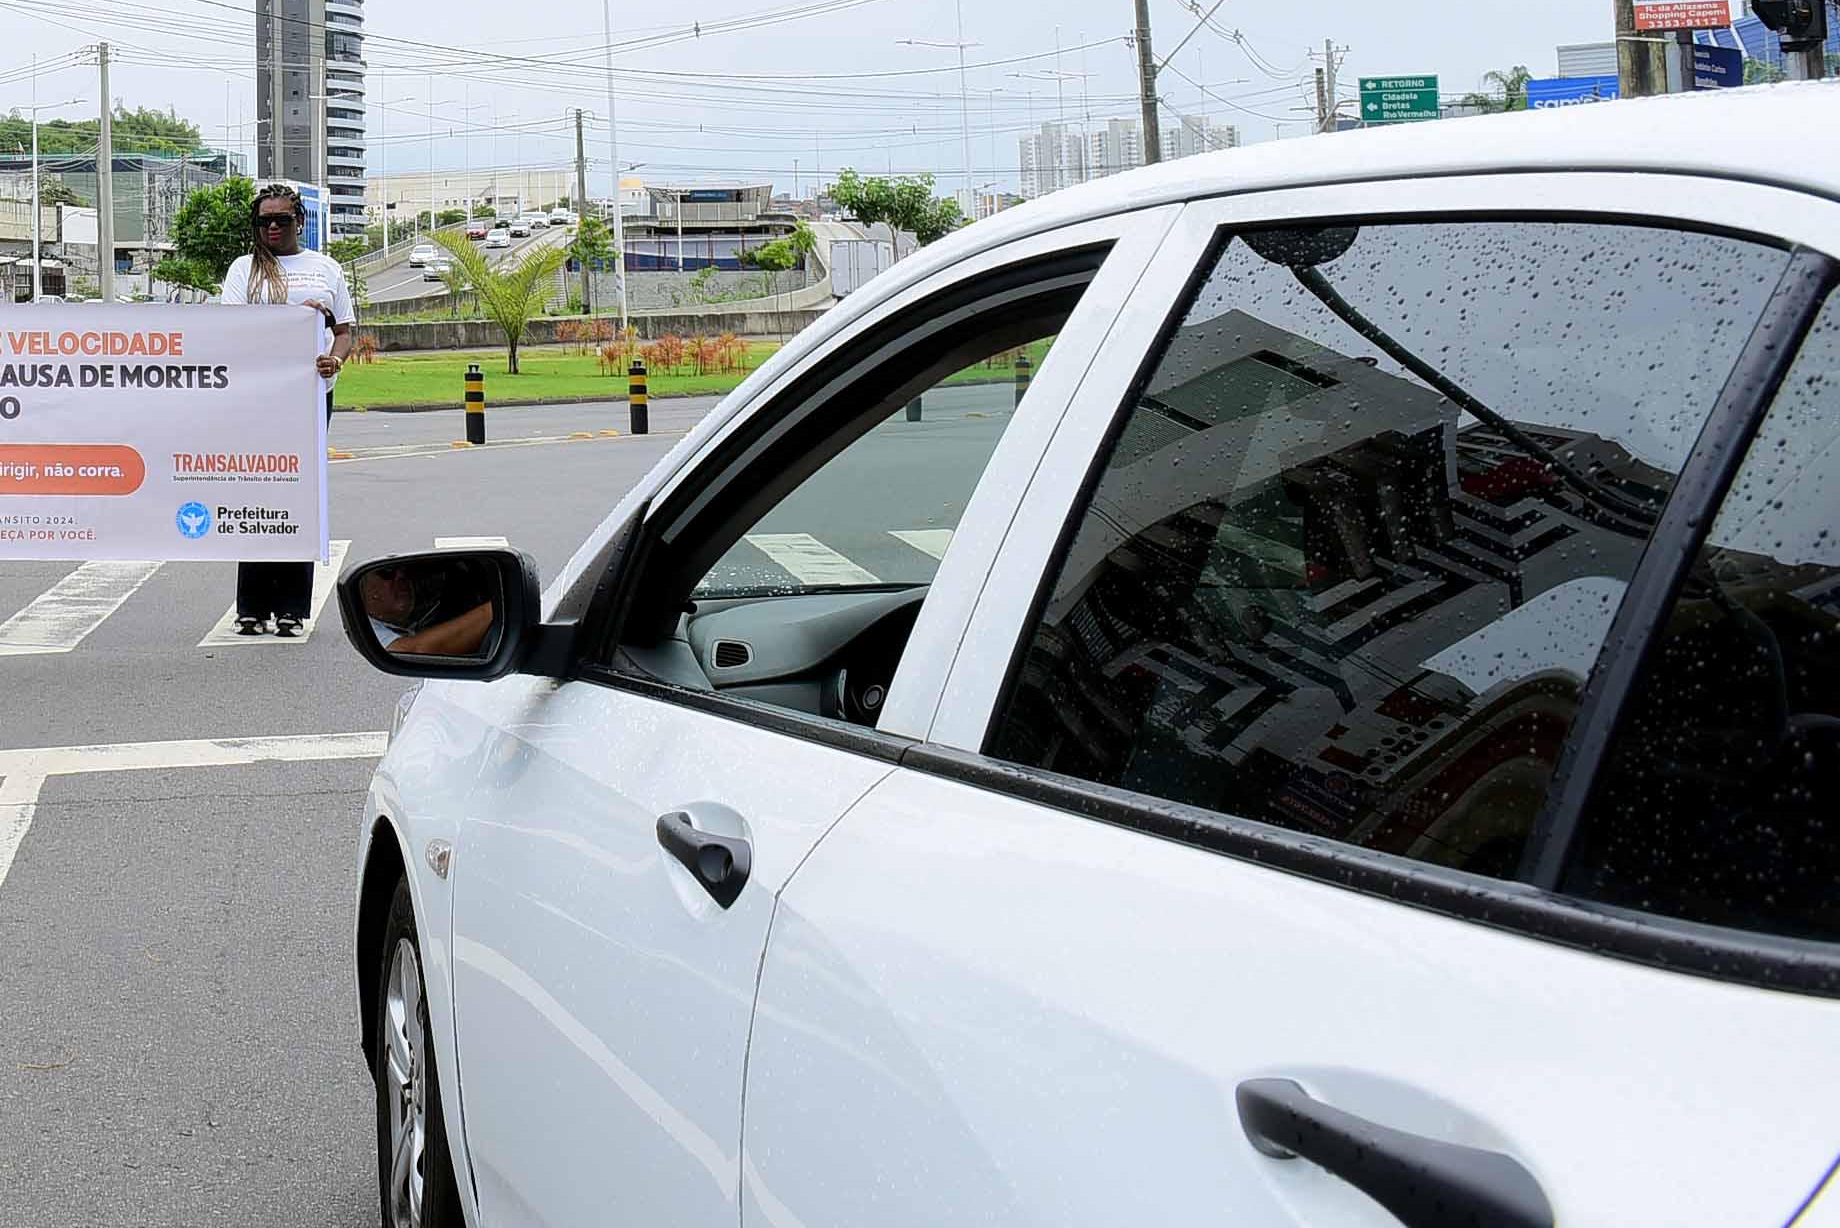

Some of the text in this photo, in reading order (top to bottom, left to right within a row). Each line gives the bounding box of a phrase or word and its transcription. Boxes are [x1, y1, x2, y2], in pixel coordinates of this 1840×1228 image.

[1639, 11, 1687, 21] Shopping
[1382, 80, 1425, 88] RETORNO
[1398, 110, 1437, 118] Vermelho
[7, 331, 183, 356] VELOCIDADE
[79, 364, 114, 389] DE
[119, 364, 229, 389] MORTES
[172, 453, 299, 473] TRANSALVADOR
[44, 462, 74, 477] não
[78, 464, 125, 478] corra.
[172, 475, 227, 483] Superintendência
[217, 506, 289, 520] Prefeitura
[45, 516, 78, 525] 2024.
[217, 521, 300, 534] de Salvador
[29, 530, 55, 540] POR
[59, 528, 97, 540] VOCÊ.
